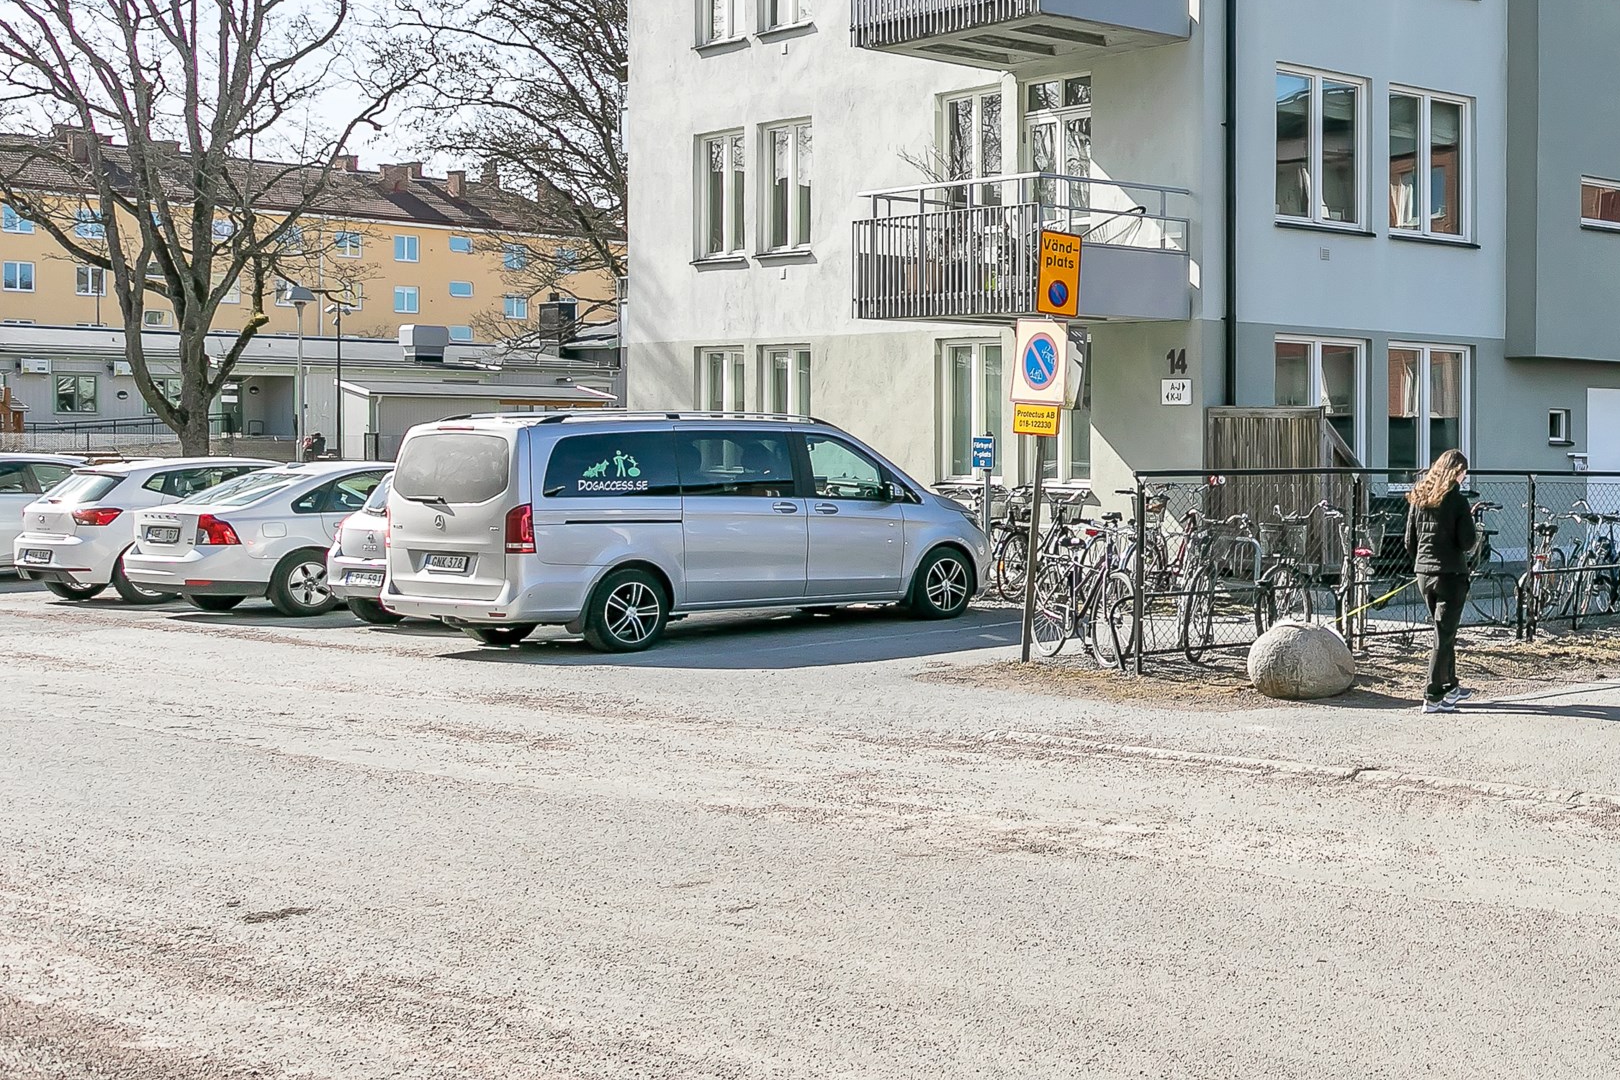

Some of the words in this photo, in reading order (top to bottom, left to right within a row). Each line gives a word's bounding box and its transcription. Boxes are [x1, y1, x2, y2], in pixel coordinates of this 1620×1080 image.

[1043, 237, 1079, 254] Vänd-
[1046, 255, 1074, 269] plats
[1166, 348, 1188, 375] 14
[1170, 382, 1181, 391] A-J
[1016, 409, 1045, 419] Protectus
[1045, 411, 1056, 420] AB
[431, 556, 448, 568] GNK
[447, 557, 464, 569] 378
